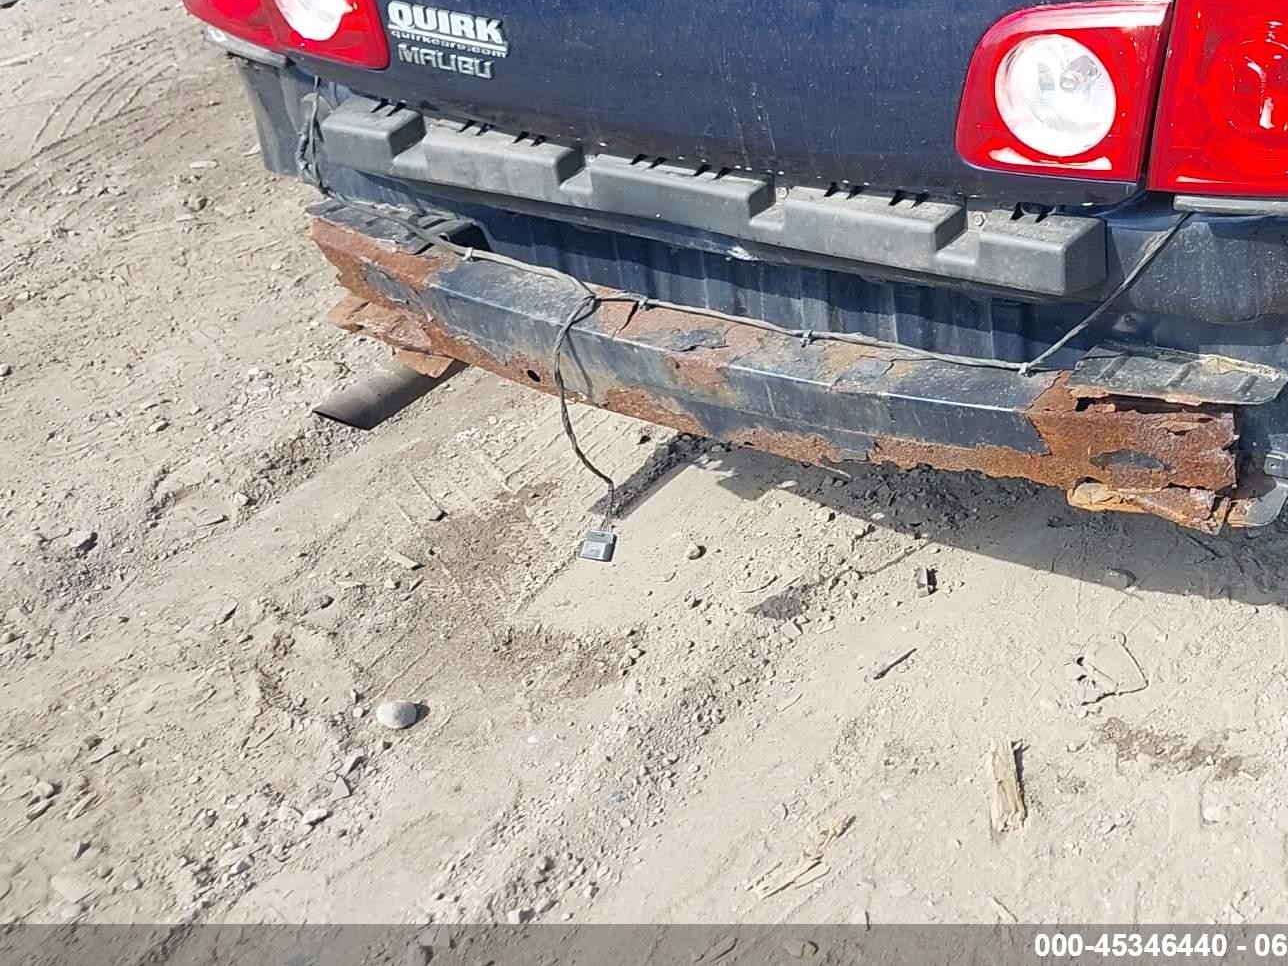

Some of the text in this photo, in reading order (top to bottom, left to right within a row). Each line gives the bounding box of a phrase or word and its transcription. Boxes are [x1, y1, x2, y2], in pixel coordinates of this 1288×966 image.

[388, 1, 504, 44] QUIRK
[391, 30, 508, 58] quirkcars.com
[398, 43, 494, 79] MALIBU
